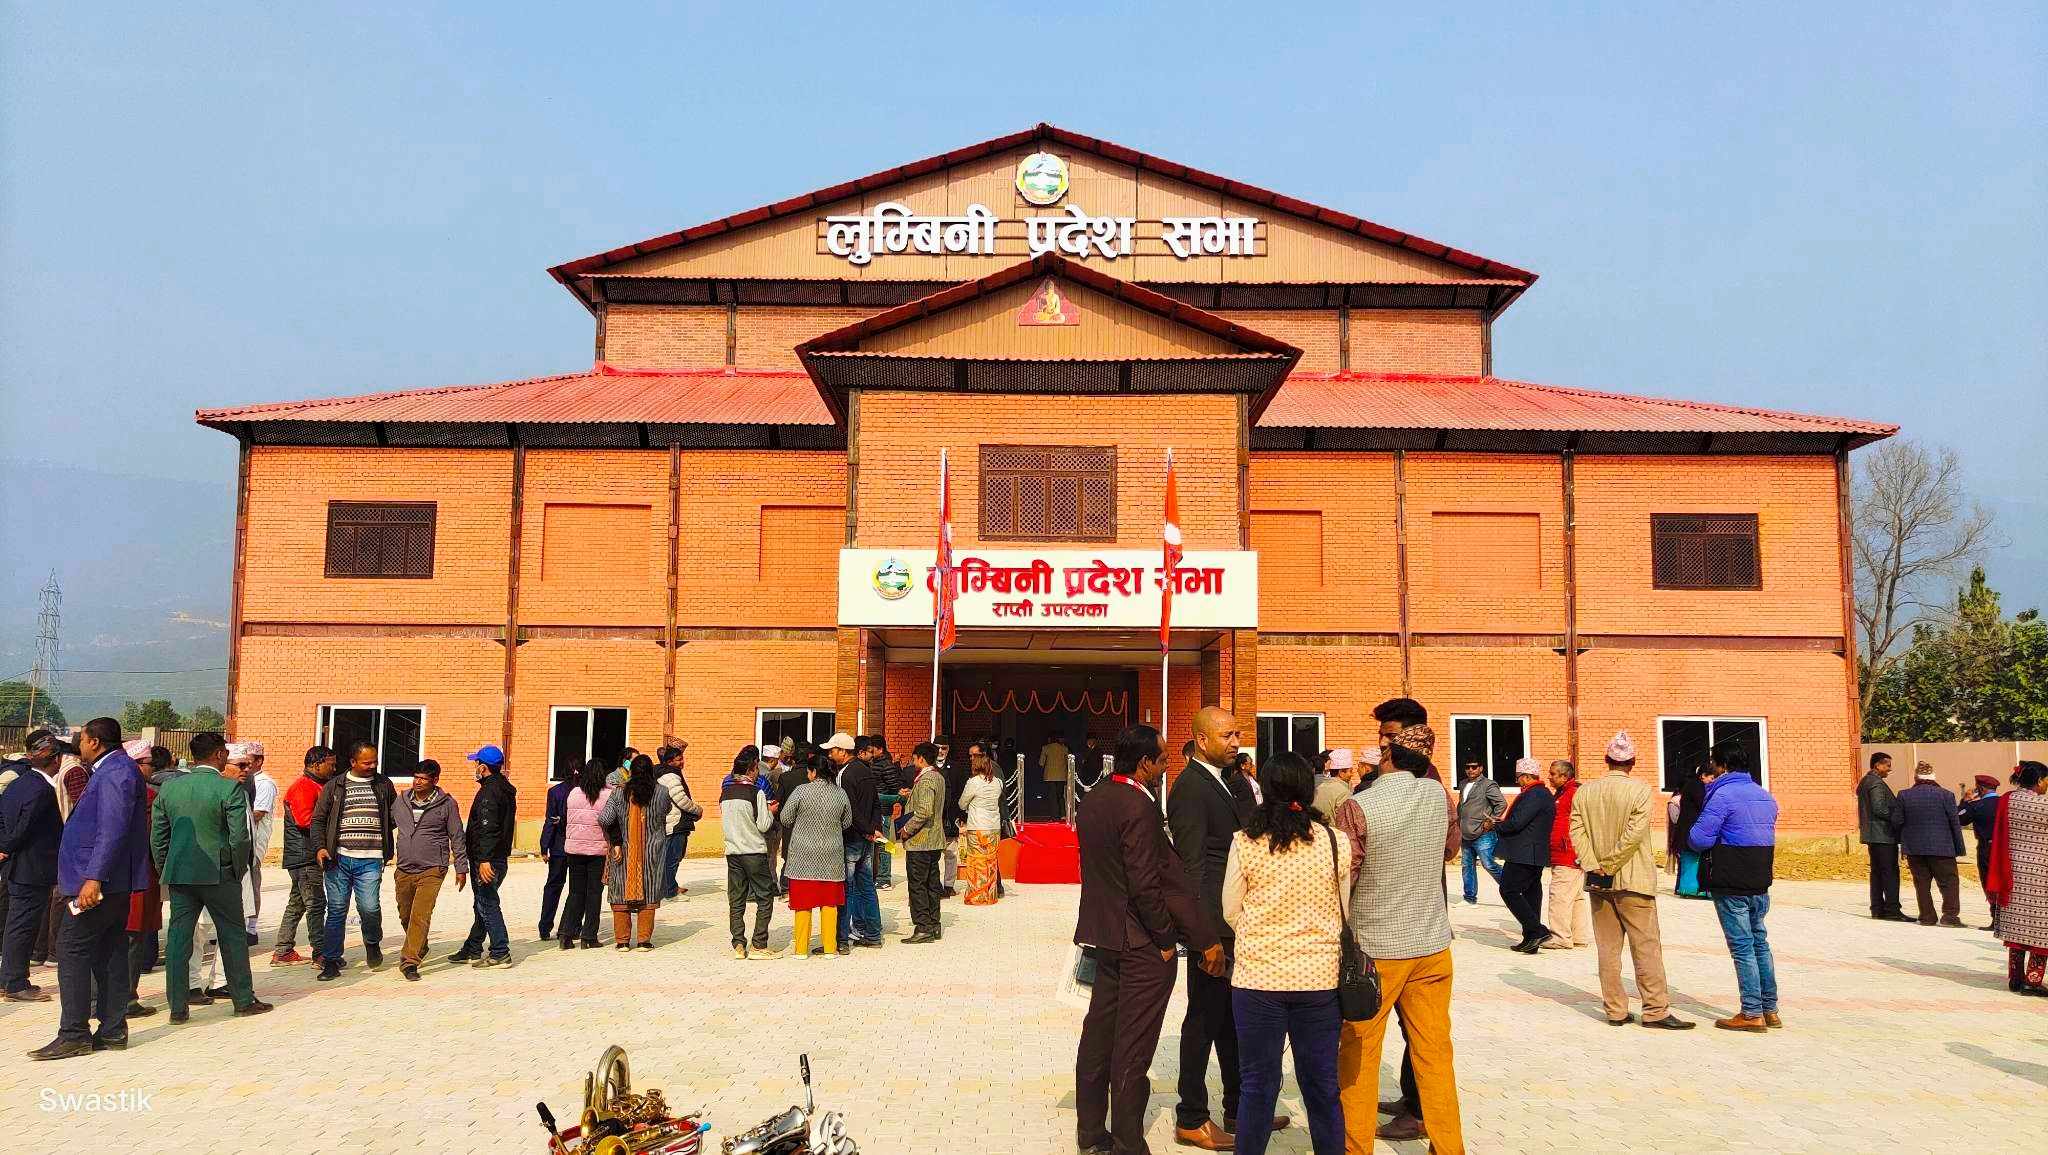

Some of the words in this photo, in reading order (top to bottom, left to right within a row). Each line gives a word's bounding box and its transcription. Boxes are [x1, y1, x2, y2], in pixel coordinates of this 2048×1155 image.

[825, 202, 1000, 264] लुम्बिनी
[1024, 203, 1137, 259] प्रदेश
[1161, 217, 1260, 258] सभा
[1063, 560, 1143, 597] प्रदेश
[992, 598, 1034, 618] राप्ती
[1041, 603, 1108, 618] उपत्यका
